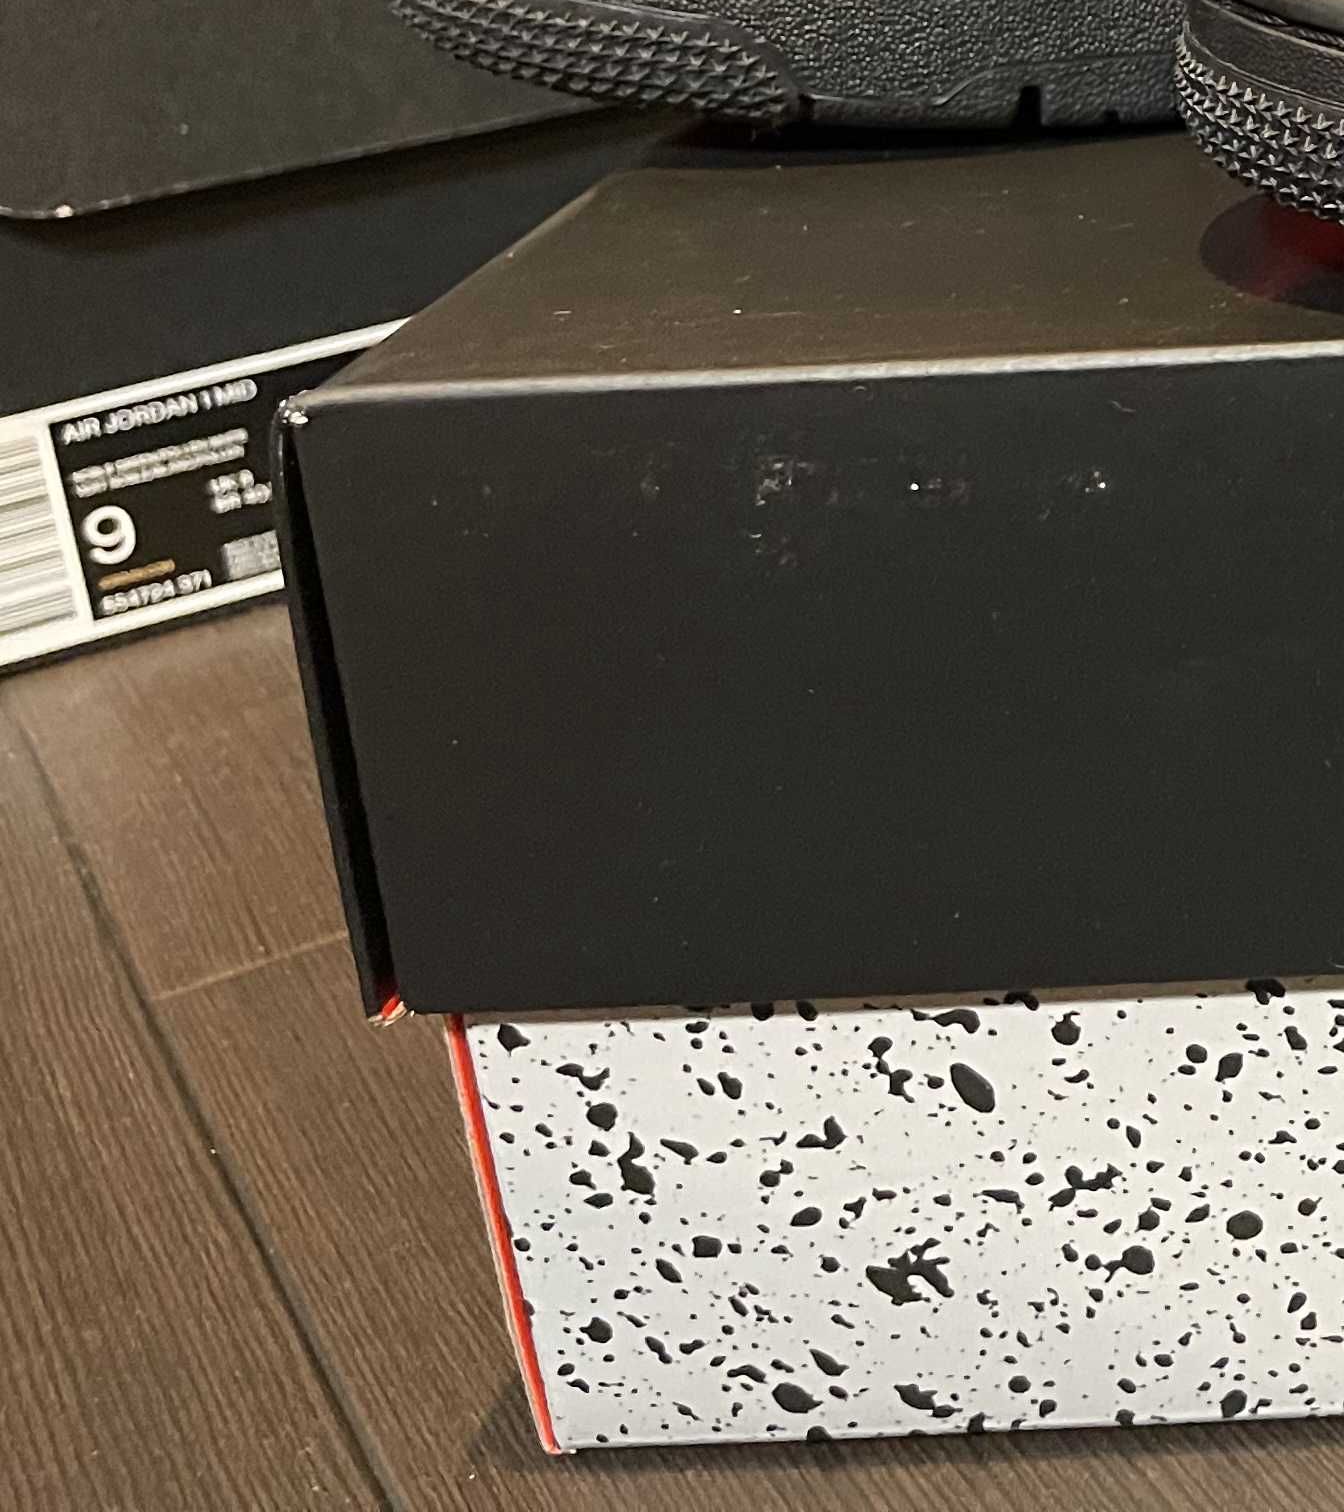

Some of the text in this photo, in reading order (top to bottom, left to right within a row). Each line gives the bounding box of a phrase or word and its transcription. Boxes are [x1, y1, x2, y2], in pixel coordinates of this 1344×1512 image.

[63, 416, 101, 445] AIR
[103, 392, 199, 435] JORDAN
[84, 504, 137, 565] 9
